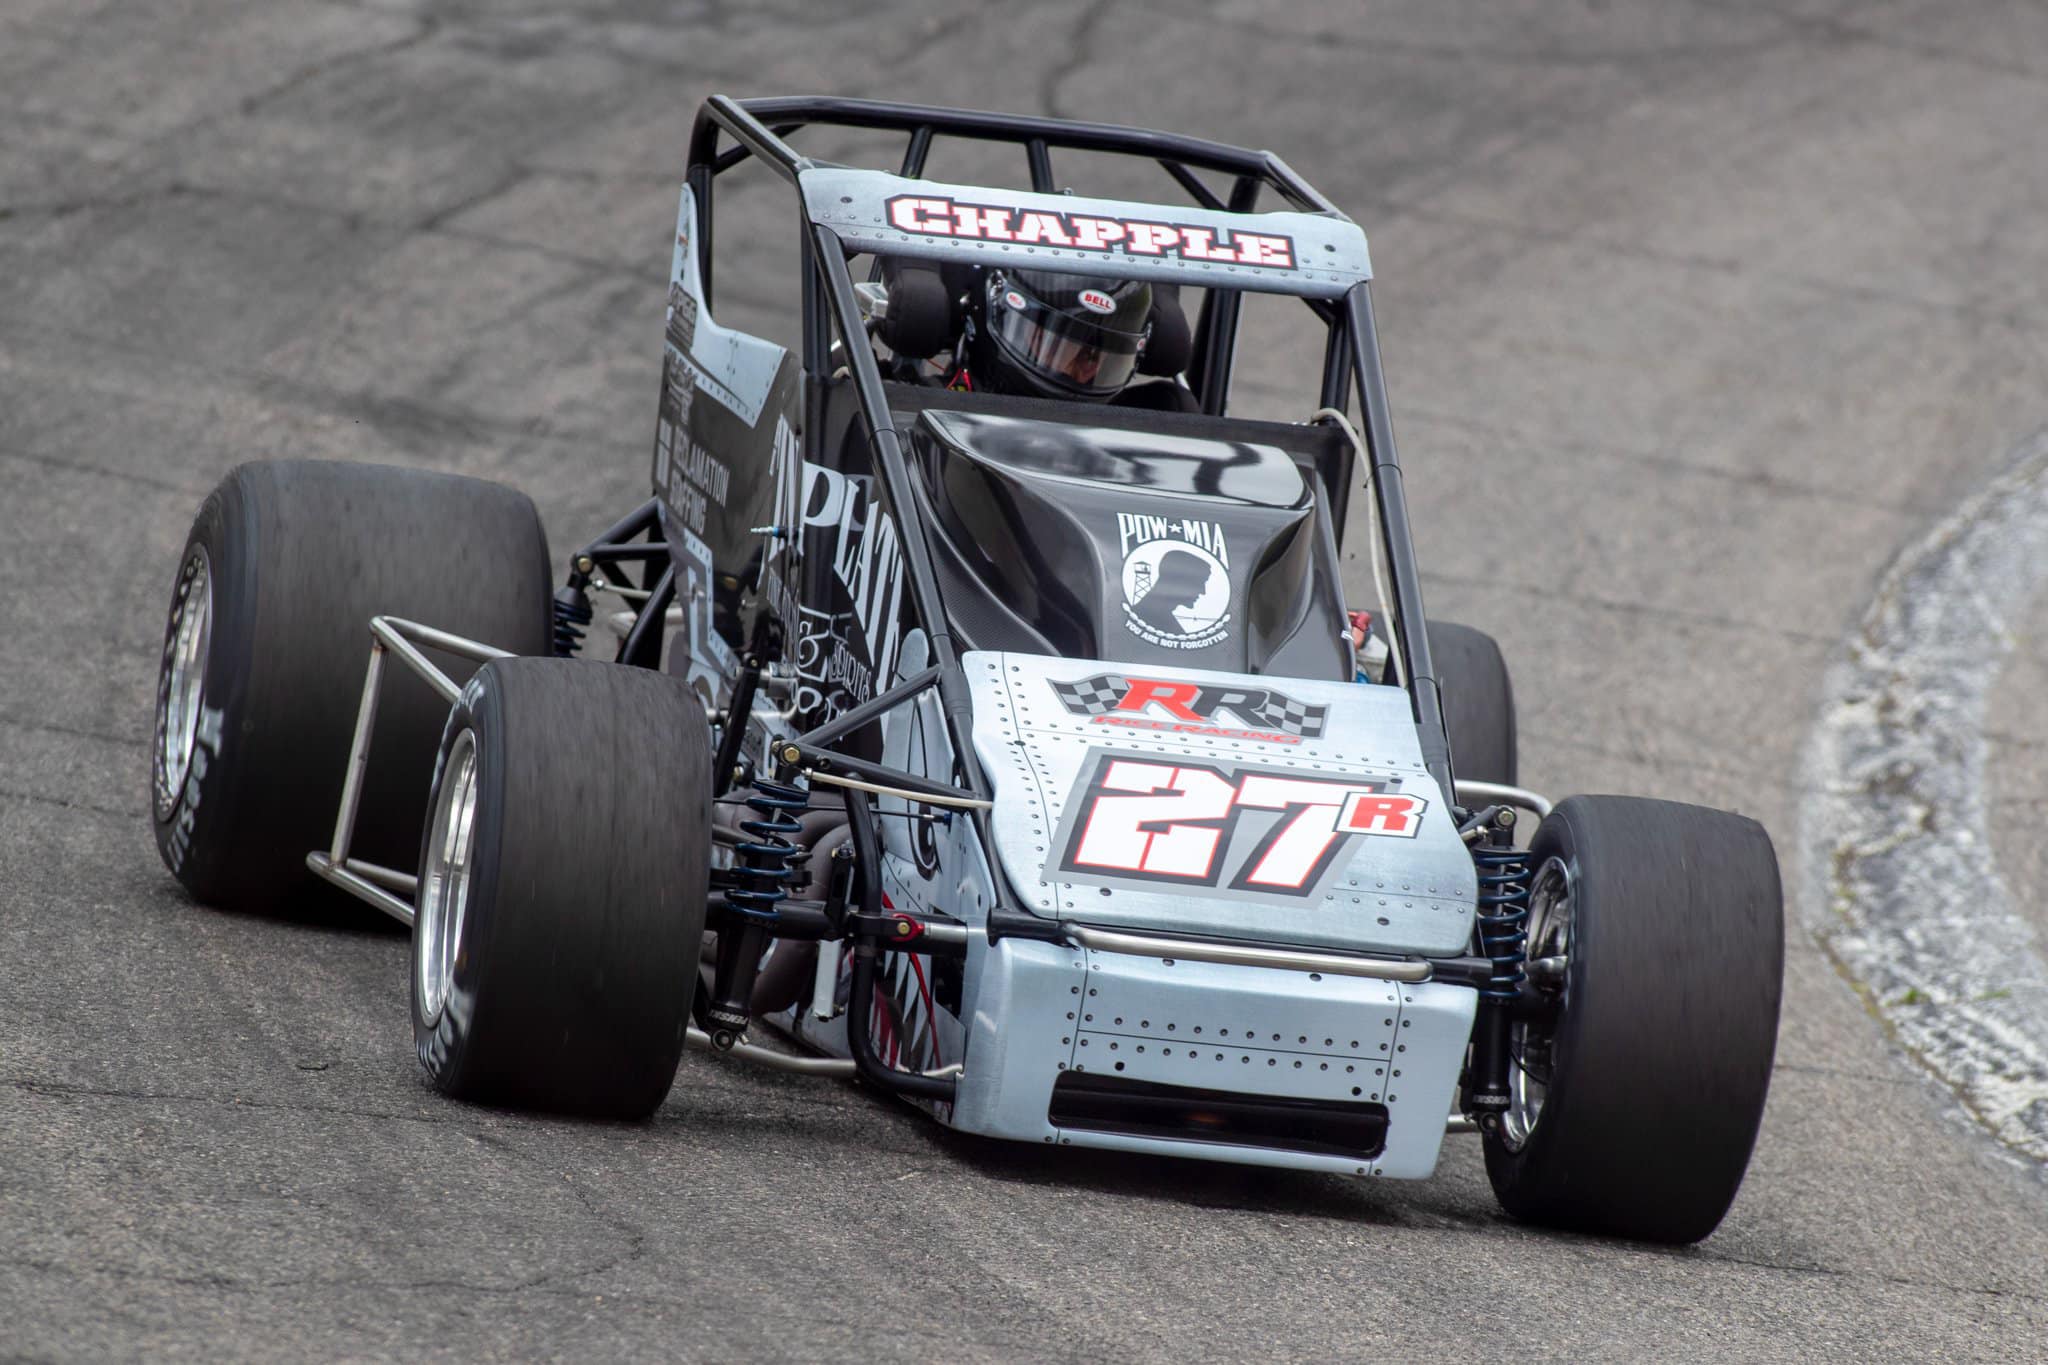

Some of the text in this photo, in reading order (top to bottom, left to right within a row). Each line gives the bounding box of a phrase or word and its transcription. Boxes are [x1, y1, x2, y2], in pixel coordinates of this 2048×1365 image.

[888, 196, 1295, 268] CHAPPLE
[1084, 293, 1112, 310] BELL
[1116, 511, 1230, 570] POW MIA
[1126, 620, 1229, 649] YOU ARE NOT FORGOTTEN
[1171, 724, 1302, 745] RACING
